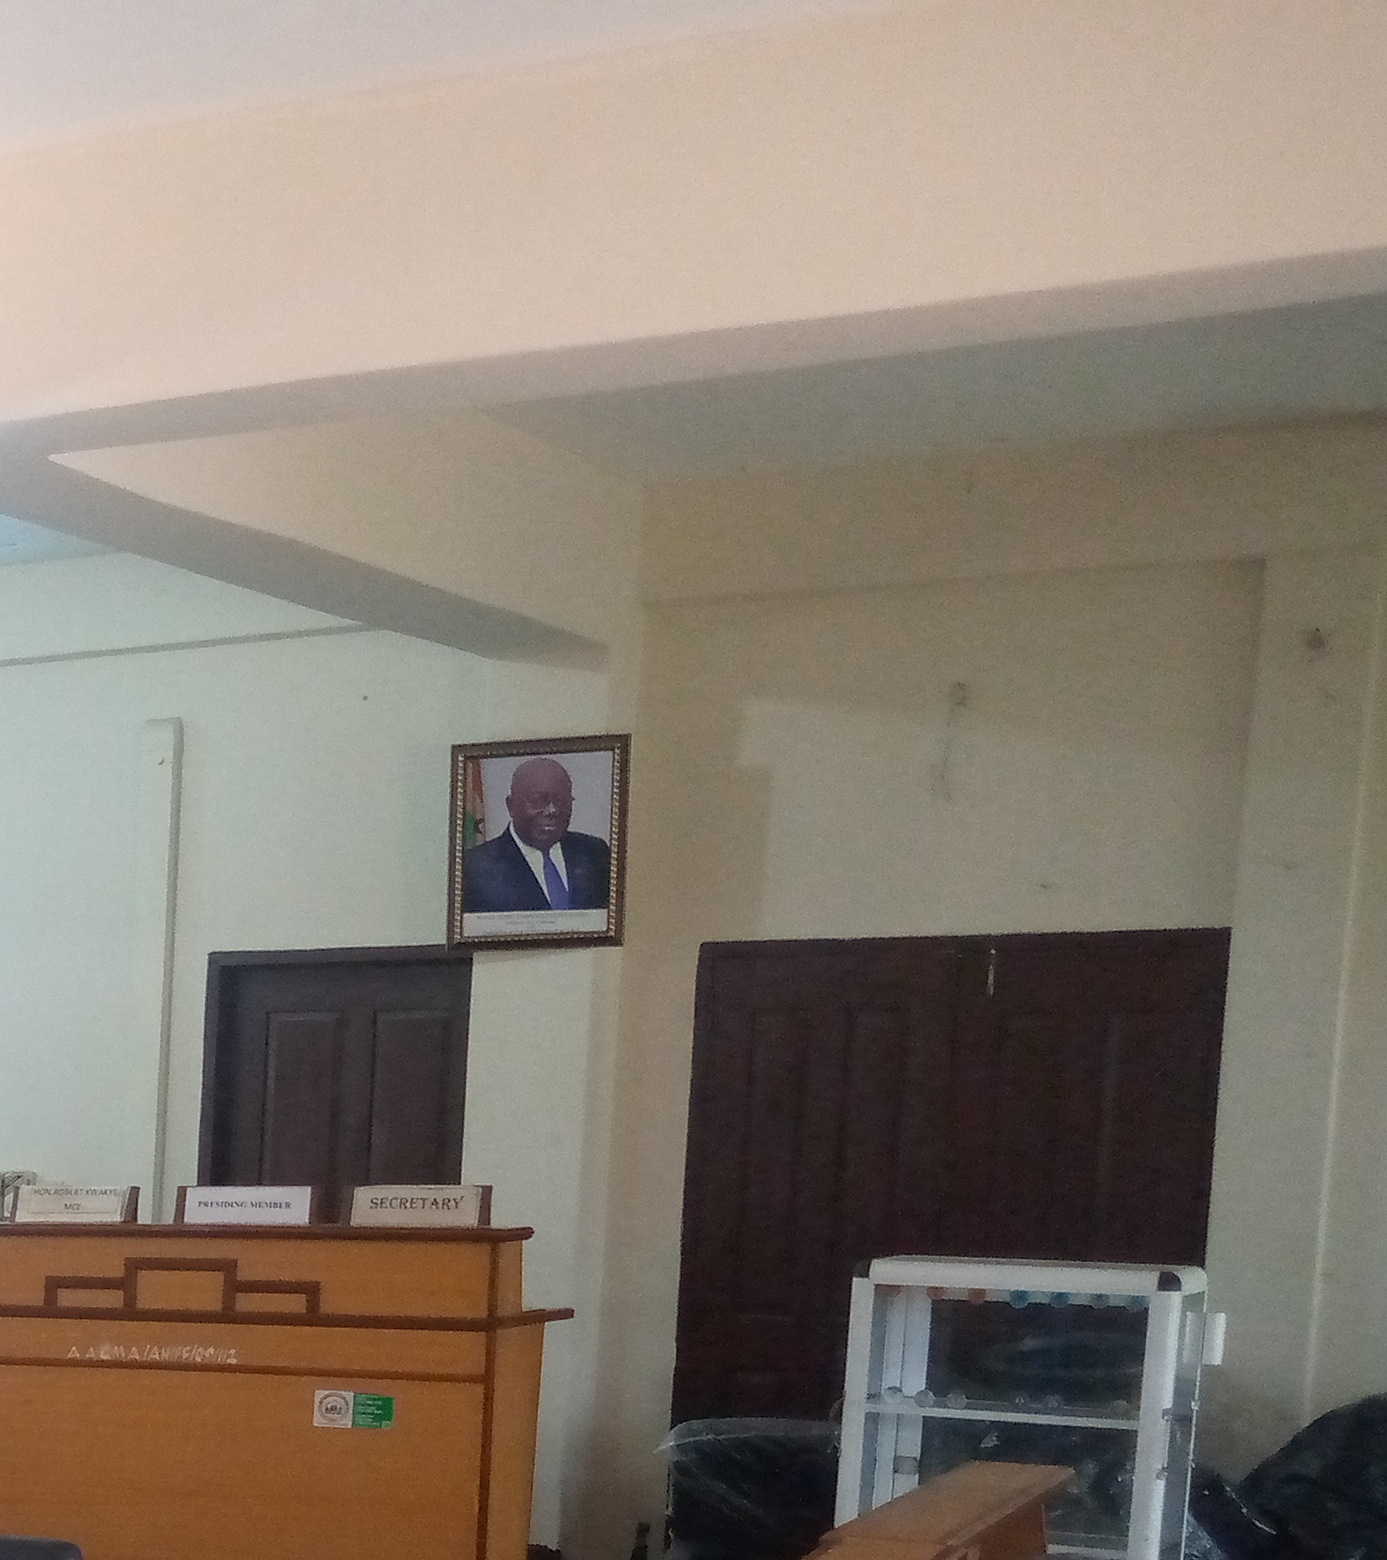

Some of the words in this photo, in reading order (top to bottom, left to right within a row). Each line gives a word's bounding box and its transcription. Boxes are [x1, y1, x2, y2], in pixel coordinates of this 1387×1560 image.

[198, 1201, 248, 1209] PRESIDING
[250, 1201, 292, 1210] MEMBER
[369, 1195, 465, 1210] SECRETARY
